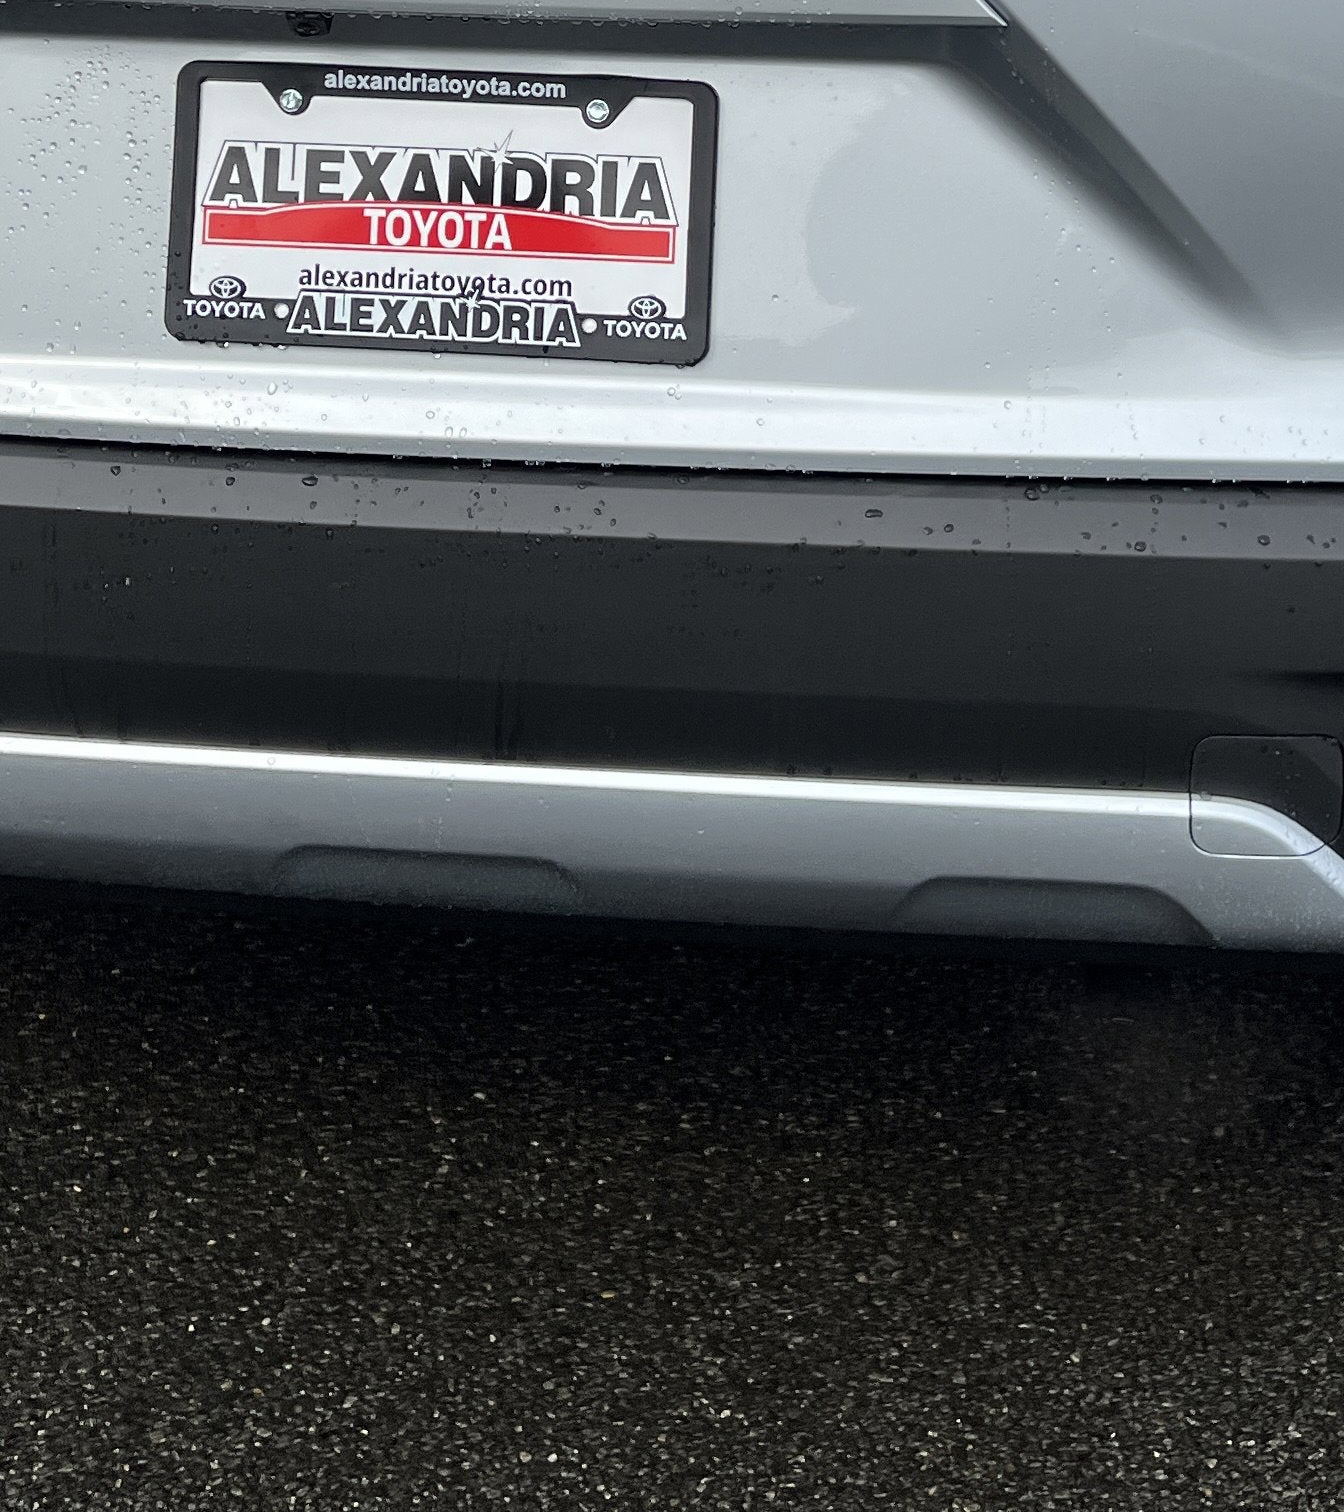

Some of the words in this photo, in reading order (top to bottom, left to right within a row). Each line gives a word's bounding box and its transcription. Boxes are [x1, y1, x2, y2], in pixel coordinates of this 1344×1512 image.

[323, 69, 566, 99] alexandriatoyota.com
[201, 141, 678, 226] ALEXANDRIA
[362, 208, 513, 251] TOYOTA
[298, 263, 573, 297] alexandriatoyota.com
[183, 299, 266, 320] TOYOTA
[286, 292, 581, 347] ALEXANDRIA
[603, 319, 687, 340] TOYOTA
